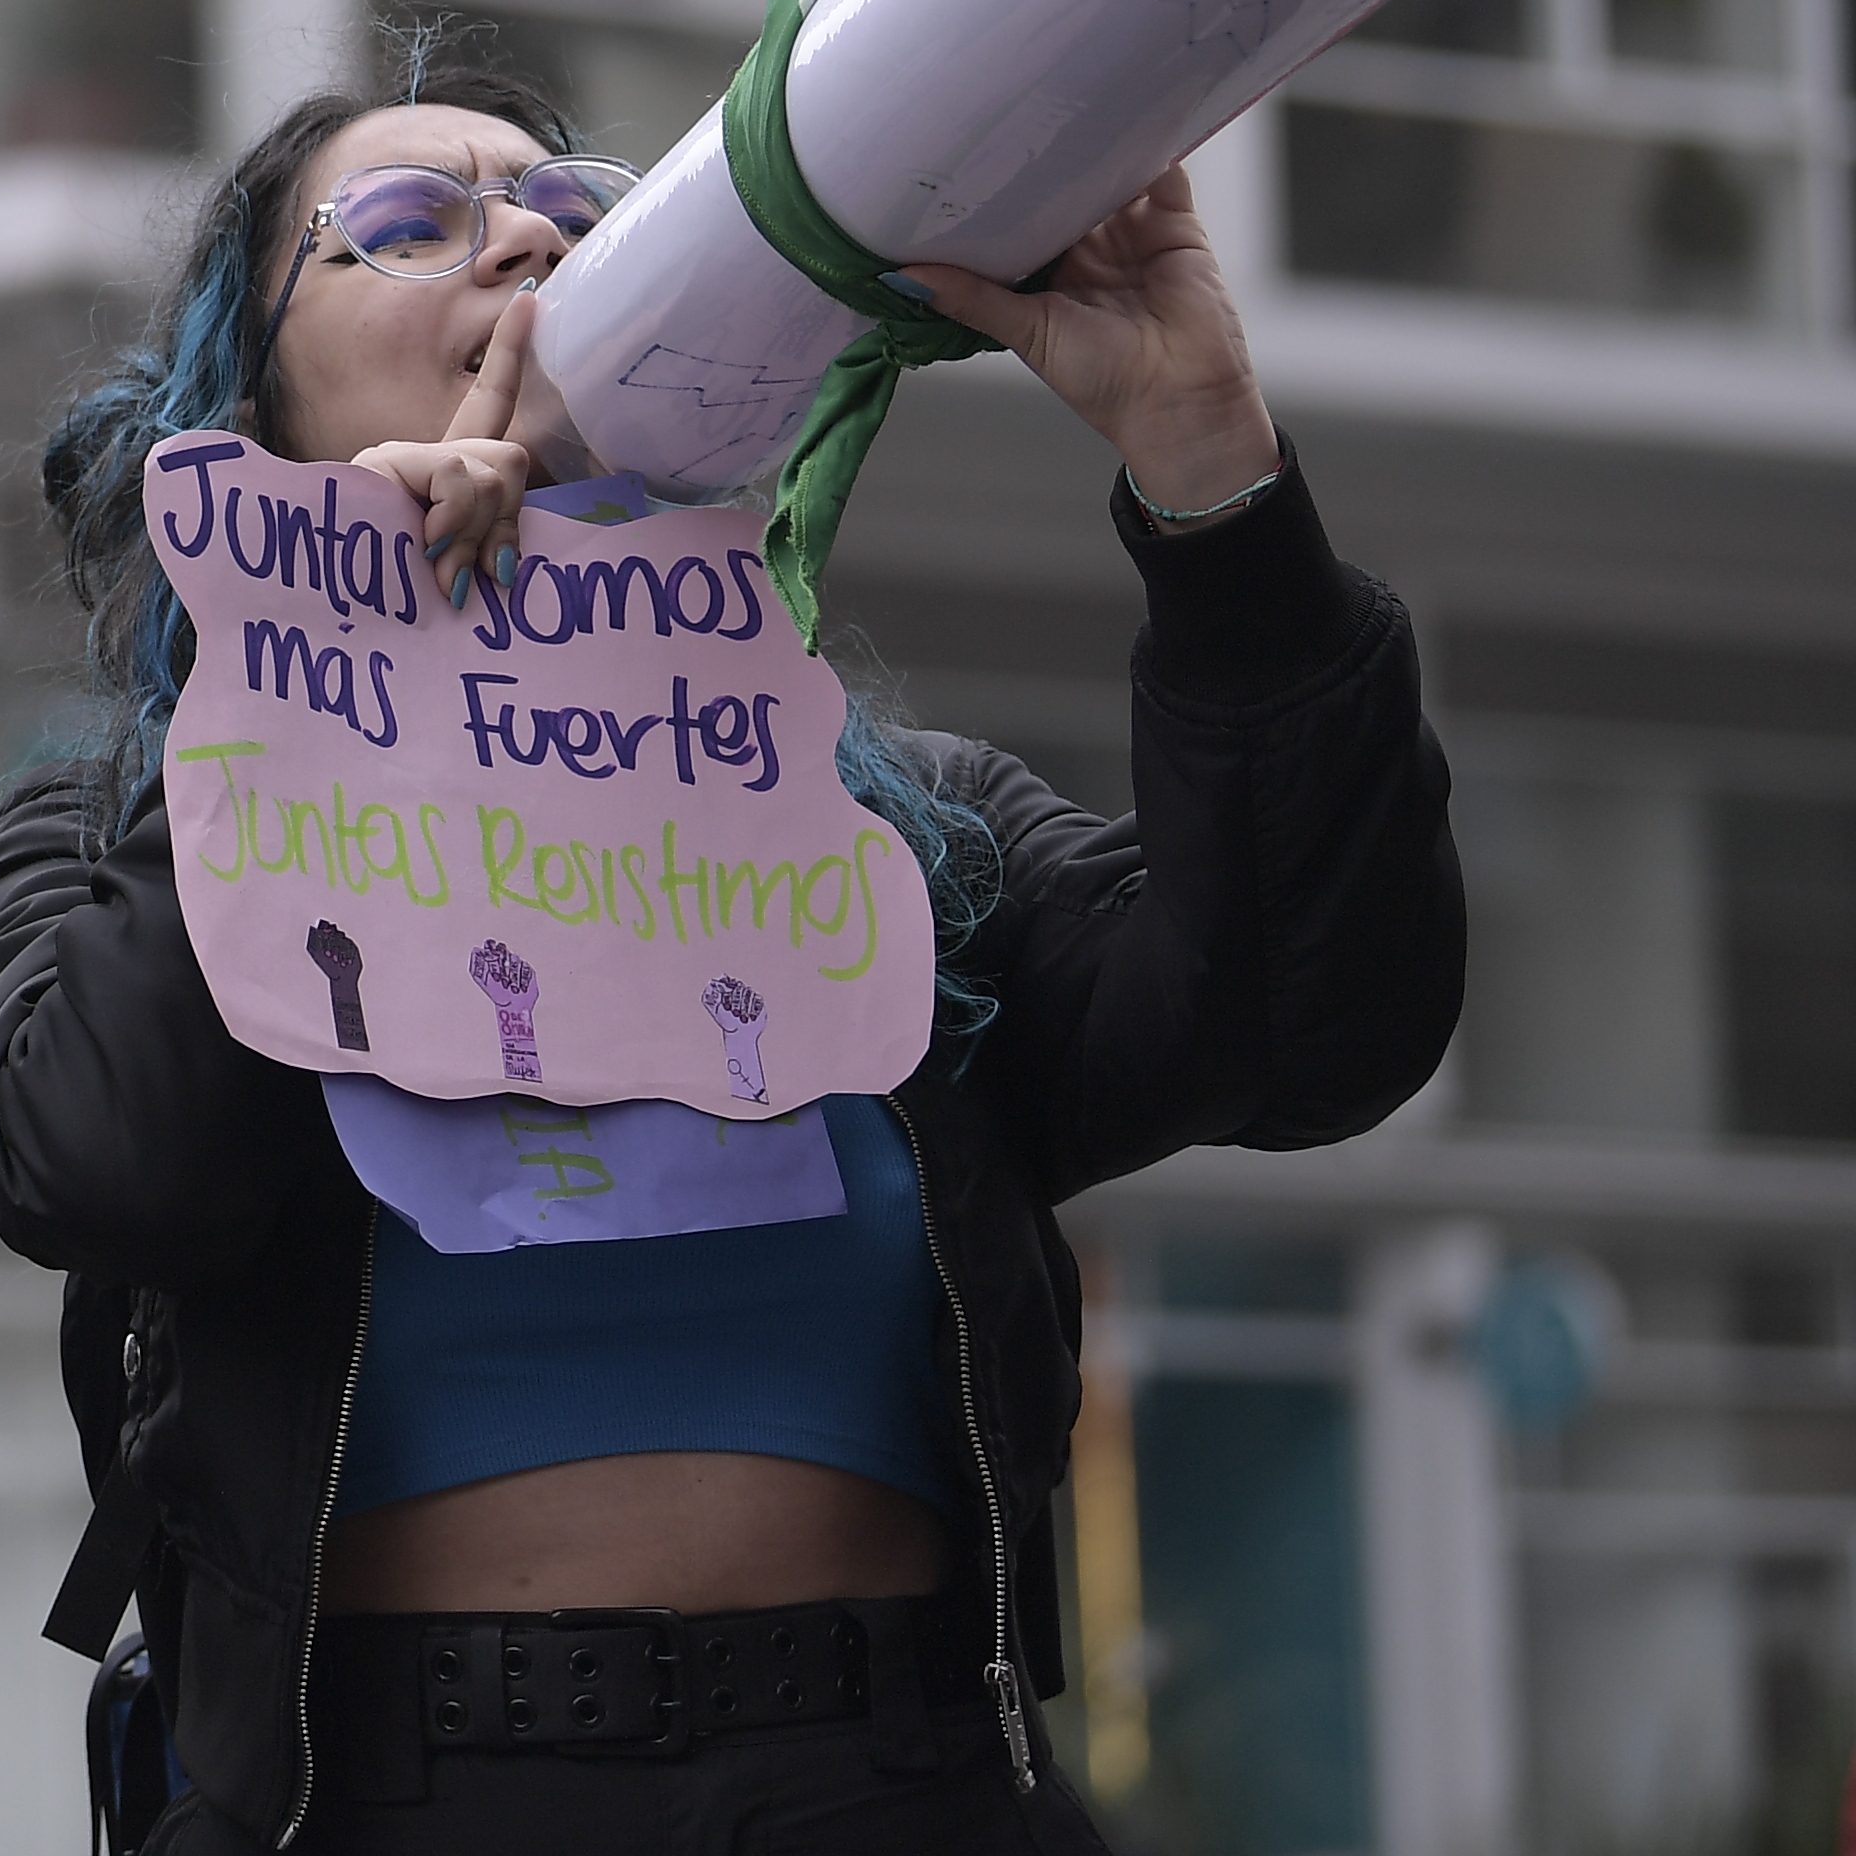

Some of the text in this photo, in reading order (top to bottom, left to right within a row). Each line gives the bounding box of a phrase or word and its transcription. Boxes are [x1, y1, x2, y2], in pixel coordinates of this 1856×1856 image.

[155, 439, 419, 628] Juntas
[242, 617, 782, 794] más Fuertes
[174, 739, 893, 984] Juntas Resistimos
